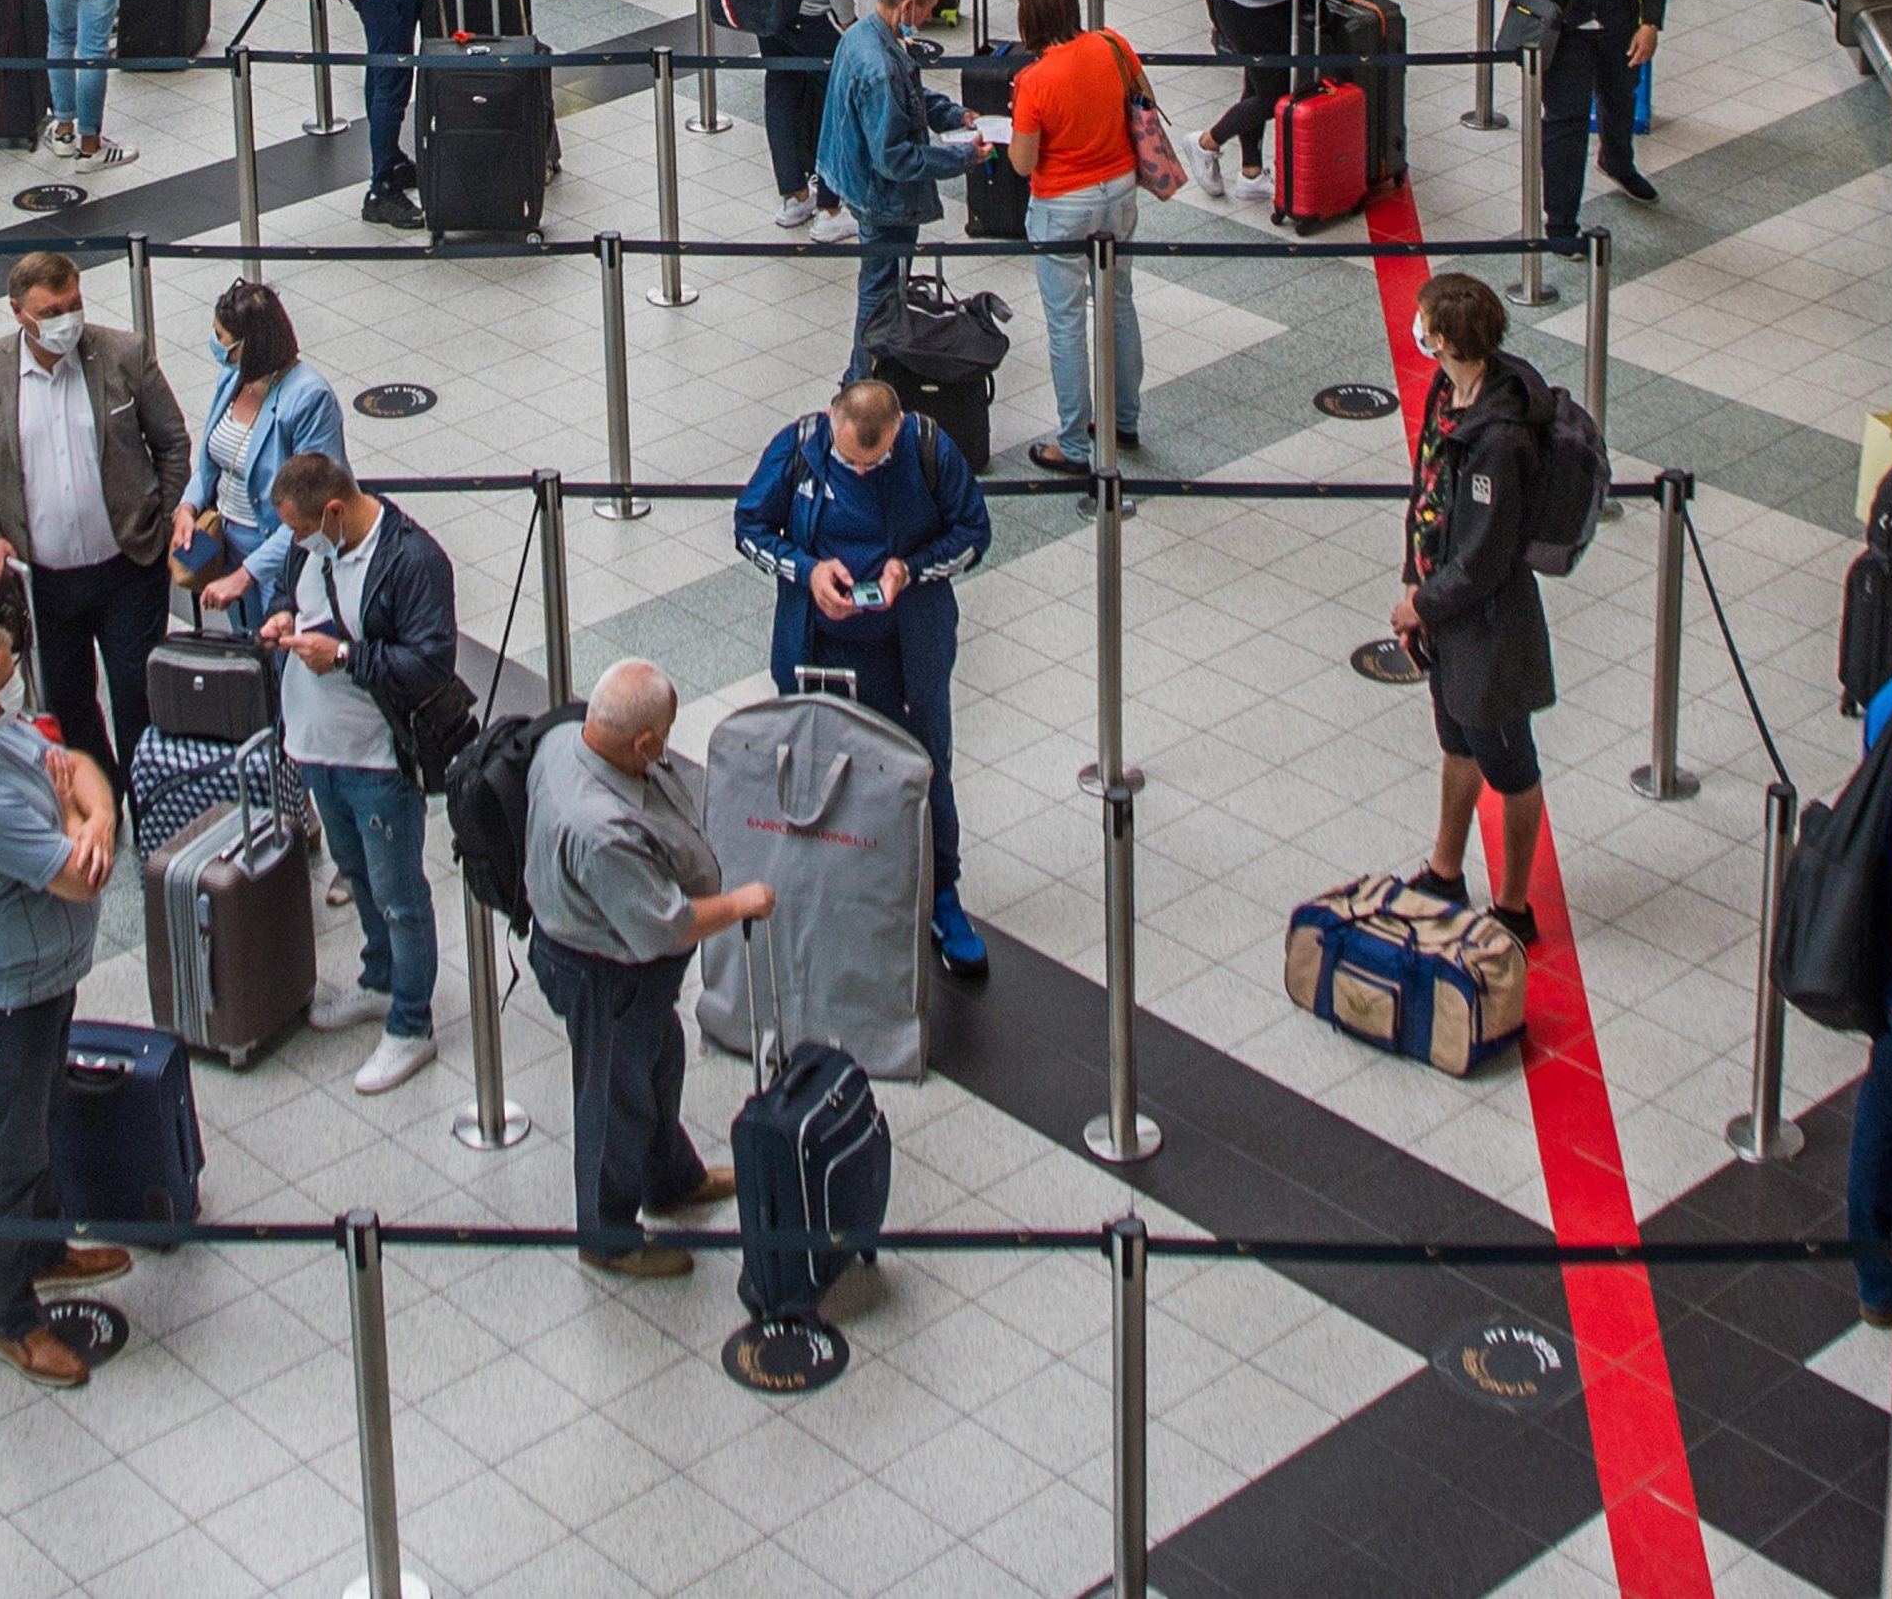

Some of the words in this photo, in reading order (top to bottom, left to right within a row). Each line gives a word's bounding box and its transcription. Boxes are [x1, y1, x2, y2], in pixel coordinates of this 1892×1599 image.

[50, 1304, 73, 1321] ITT
[763, 1322, 785, 1339] ITT
[1482, 1327, 1507, 1345] ITT
